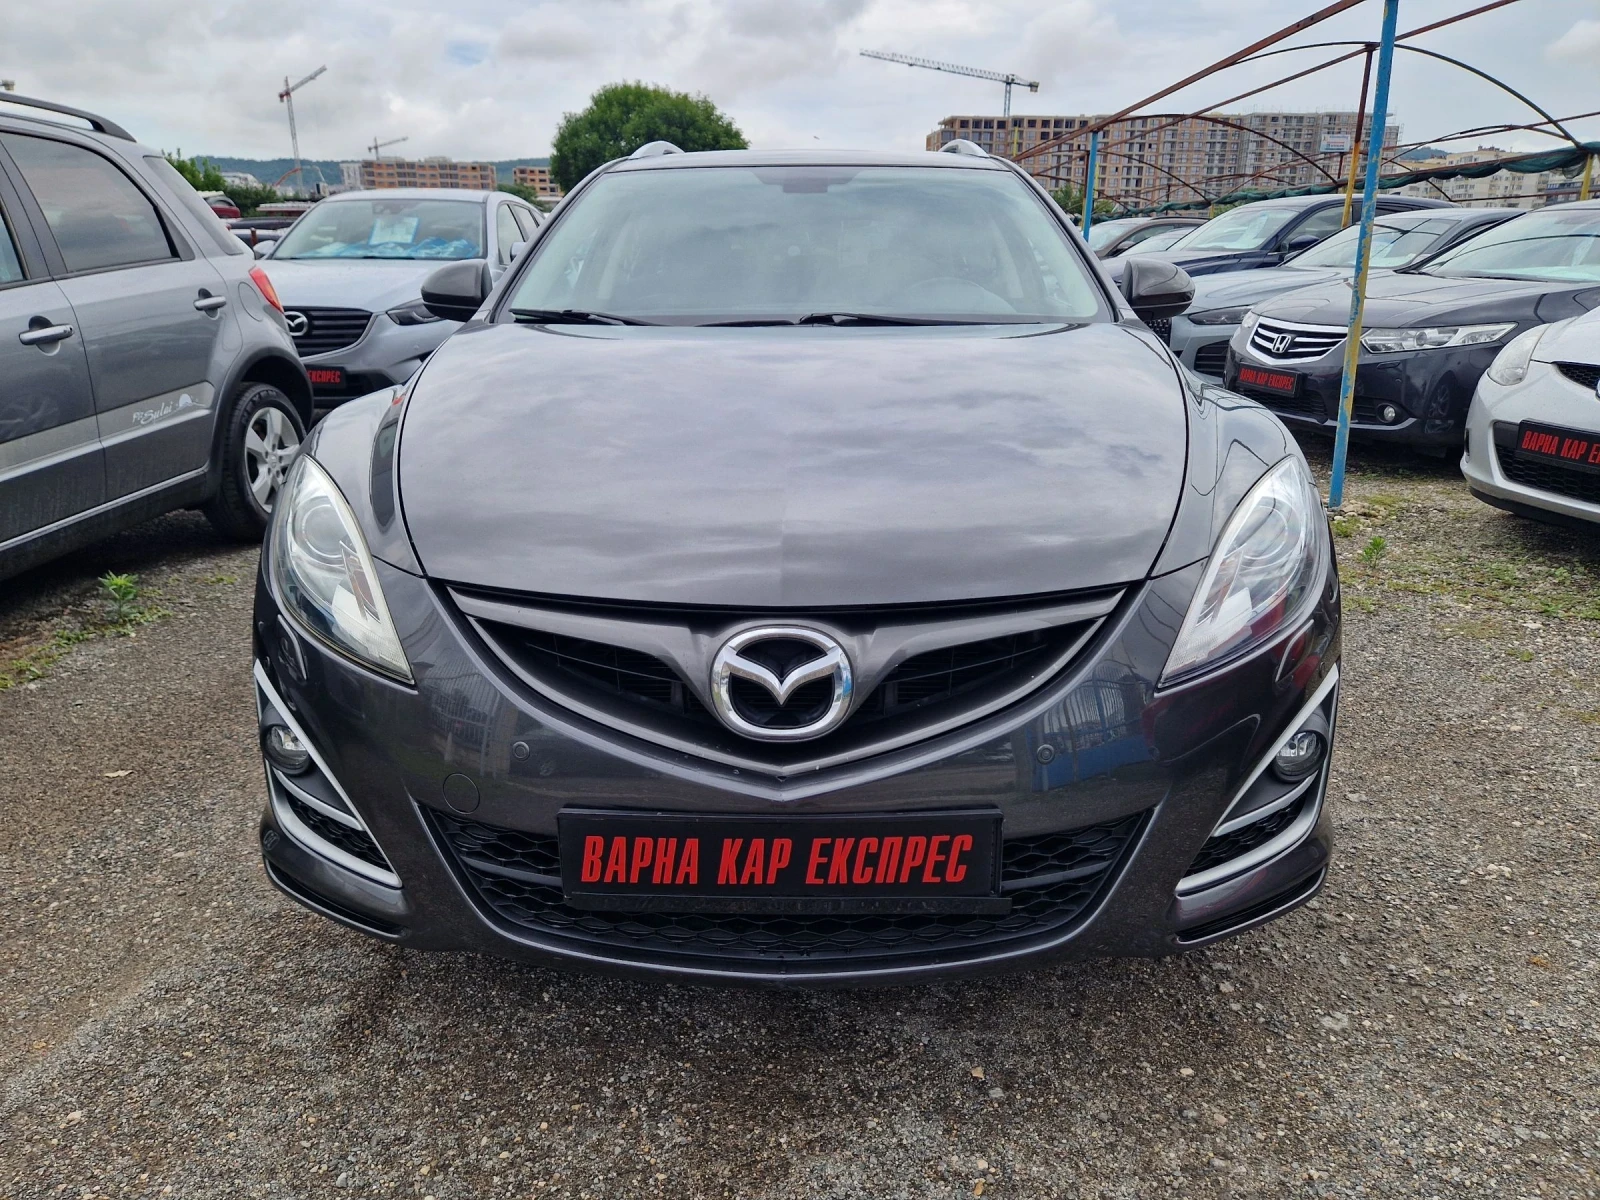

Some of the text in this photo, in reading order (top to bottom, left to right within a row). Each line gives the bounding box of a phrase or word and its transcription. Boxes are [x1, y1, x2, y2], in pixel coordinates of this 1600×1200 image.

[1521, 430, 1559, 455] ВАРНА
[1560, 437, 1588, 460] КАР
[580, 834, 973, 885] ВАРНА КАР ЕКСПРЕС
